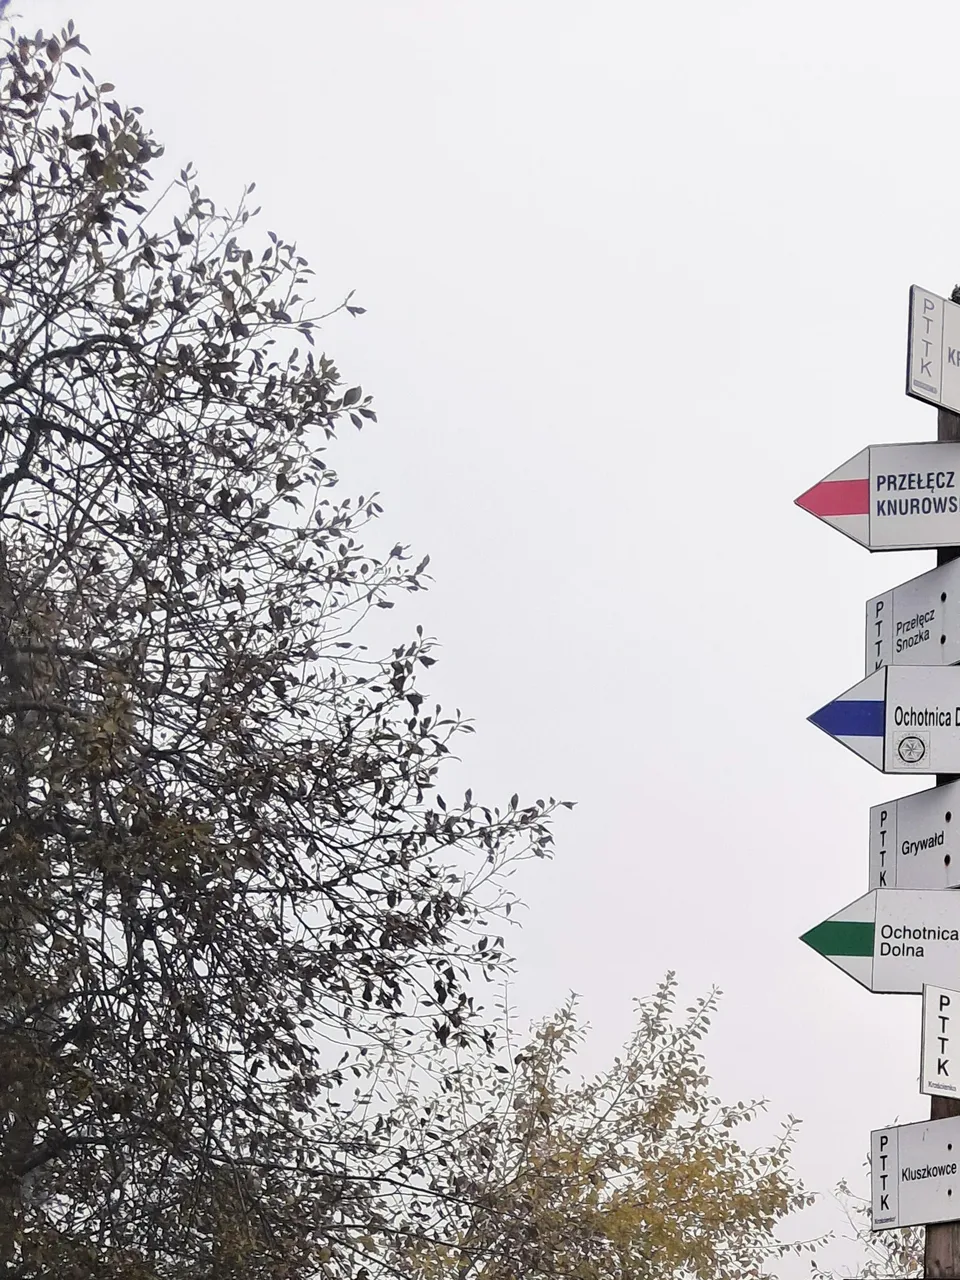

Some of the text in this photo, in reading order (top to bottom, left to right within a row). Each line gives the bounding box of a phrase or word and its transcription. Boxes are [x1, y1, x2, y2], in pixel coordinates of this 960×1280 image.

[877, 471, 955, 493] PRZEŁĘCZ
[896, 629, 930, 653] Snozka
[894, 706, 952, 727] Ochotnica
[902, 831, 944, 856] Grywałd
[881, 925, 959, 941] Ochotnica
[880, 942, 924, 958] Dolna
[901, 1161, 957, 1182] Kluszkowce
